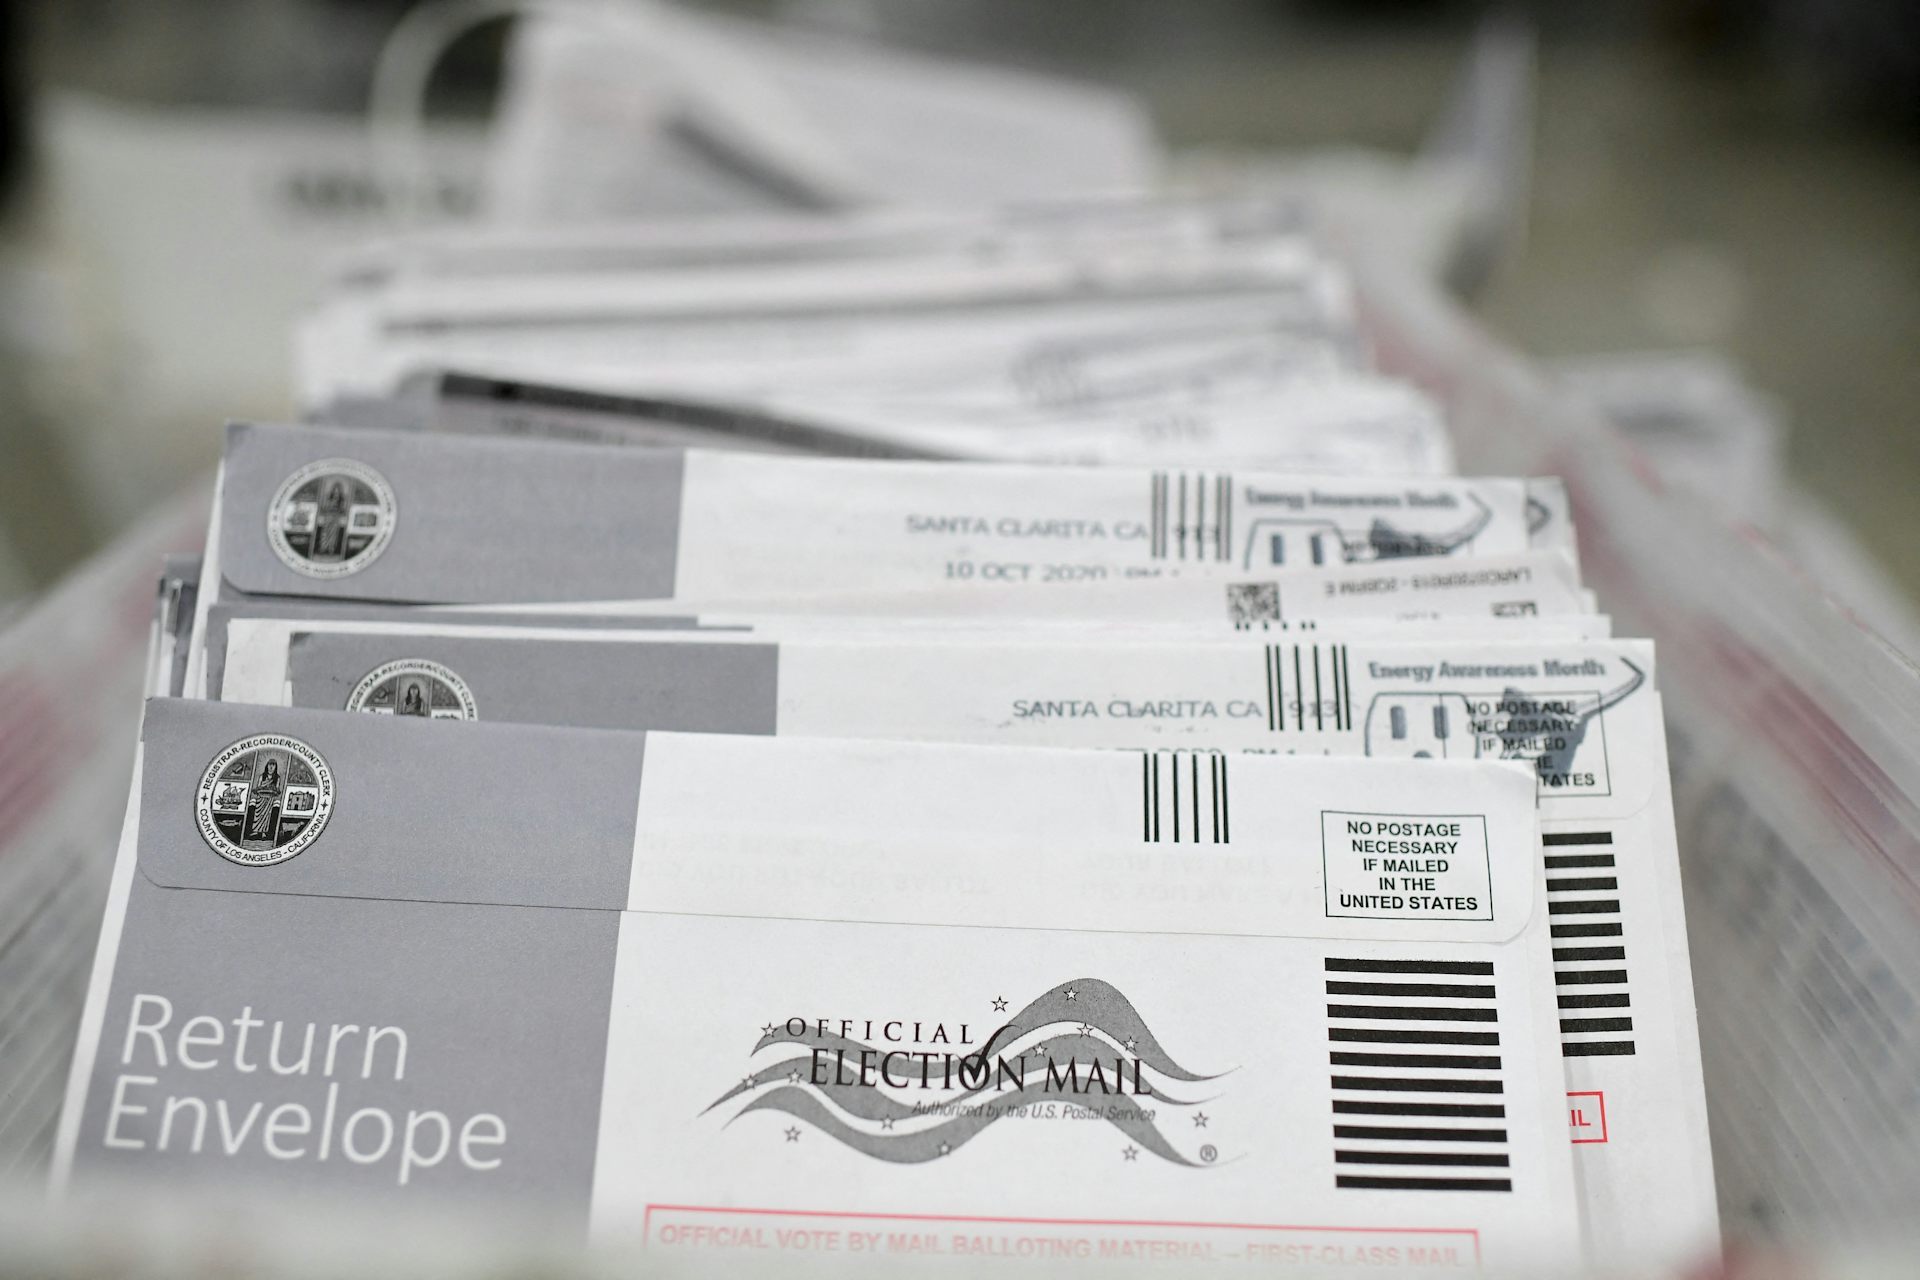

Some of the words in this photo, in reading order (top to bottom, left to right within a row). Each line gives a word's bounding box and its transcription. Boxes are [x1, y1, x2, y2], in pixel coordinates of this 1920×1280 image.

[906, 514, 990, 536] SANTA
[998, 518, 1107, 540] CLARITA
[1114, 520, 1149, 541] CA
[946, 561, 974, 580] 10
[981, 562, 1032, 581] OCT
[1369, 661, 1434, 682] Energy
[1439, 660, 1538, 678] Awareness
[1544, 659, 1605, 677] Month
[1013, 700, 1098, 718] SANTA
[1107, 700, 1218, 719] CLARITA
[1226, 700, 1262, 718] CA
[1466, 700, 1490, 715] NO
[1496, 700, 1576, 716] POSTAGE
[1470, 719, 1576, 734] NECESSARY
[1482, 739, 1496, 751] IF
[1502, 737, 1567, 751] MAILED
[319, 769, 331, 797] CLERK
[1538, 772, 1595, 787] TATES
[200, 808, 216, 840] COUNTY
[215, 839, 228, 849] OF
[227, 848, 242, 859] LOS
[242, 850, 282, 862] ANGELES
[287, 813, 327, 853] CALIFORNIA
[1347, 820, 1371, 835] NO
[1377, 823, 1461, 837] POSTAGE
[1352, 839, 1458, 854] NECESSARY
[1363, 858, 1377, 871] IF
[1383, 859, 1449, 873] MAILED
[1379, 877, 1395, 890] IN
[1400, 878, 1436, 891] THE
[1340, 894, 1404, 909] UNITED
[1409, 896, 1478, 910] STATES
[121, 993, 409, 1081] Return
[785, 1017, 974, 1045] OFFICIAL
[809, 1047, 1026, 1095] ELECTION
[1043, 1055, 1153, 1096] MAIL
[911, 1099, 983, 1120] Authorized
[983, 1101, 1004, 1123] by
[1006, 1102, 1029, 1119] the
[1031, 1104, 1058, 1120] U.S.
[1062, 1104, 1104, 1121] Postal
[1104, 1105, 1157, 1122] Service
[1569, 1109, 1591, 1126] IL
[103, 1073, 508, 1186] Envelope
[660, 1223, 769, 1249] OFFICIAL
[775, 1228, 840, 1251] VOTE
[848, 1231, 881, 1252] BY
[887, 1232, 946, 1255] MAIL
[952, 1235, 1090, 1260] BALLOTING
[1099, 1238, 1219, 1262] MATERIAL
[1246, 1242, 1401, 1267] FIRST-CLASS
[1407, 1246, 1462, 1268] MAIL
